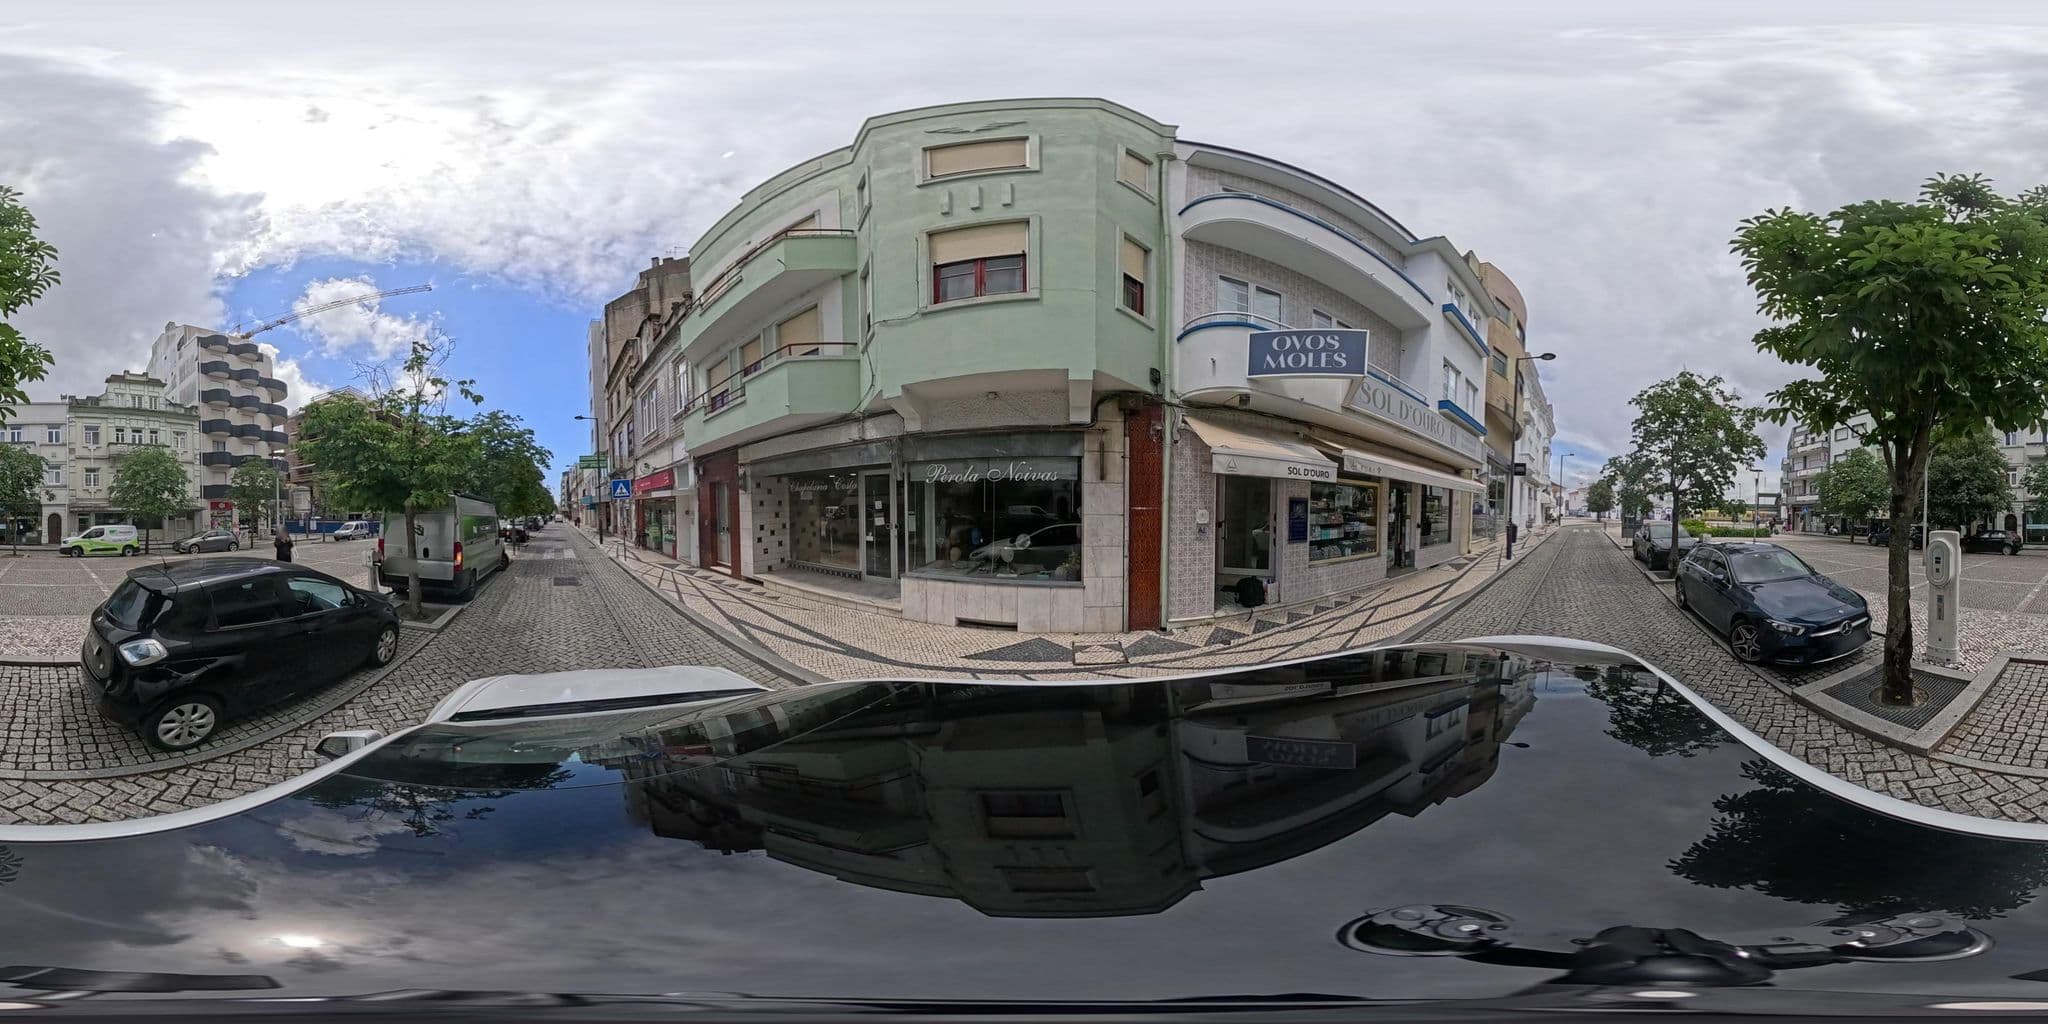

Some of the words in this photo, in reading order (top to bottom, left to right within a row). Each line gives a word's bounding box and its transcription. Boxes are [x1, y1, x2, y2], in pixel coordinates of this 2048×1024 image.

[1272, 335, 1340, 351] OVOS
[1263, 352, 1347, 369] MOLES
[1361, 382, 1395, 416] SOL
[1399, 400, 1445, 438] D'OURO
[926, 463, 980, 484] Pérola
[987, 461, 1058, 482] Noivas
[1287, 466, 1302, 476] SOL
[1303, 467, 1330, 479] D'OURO
